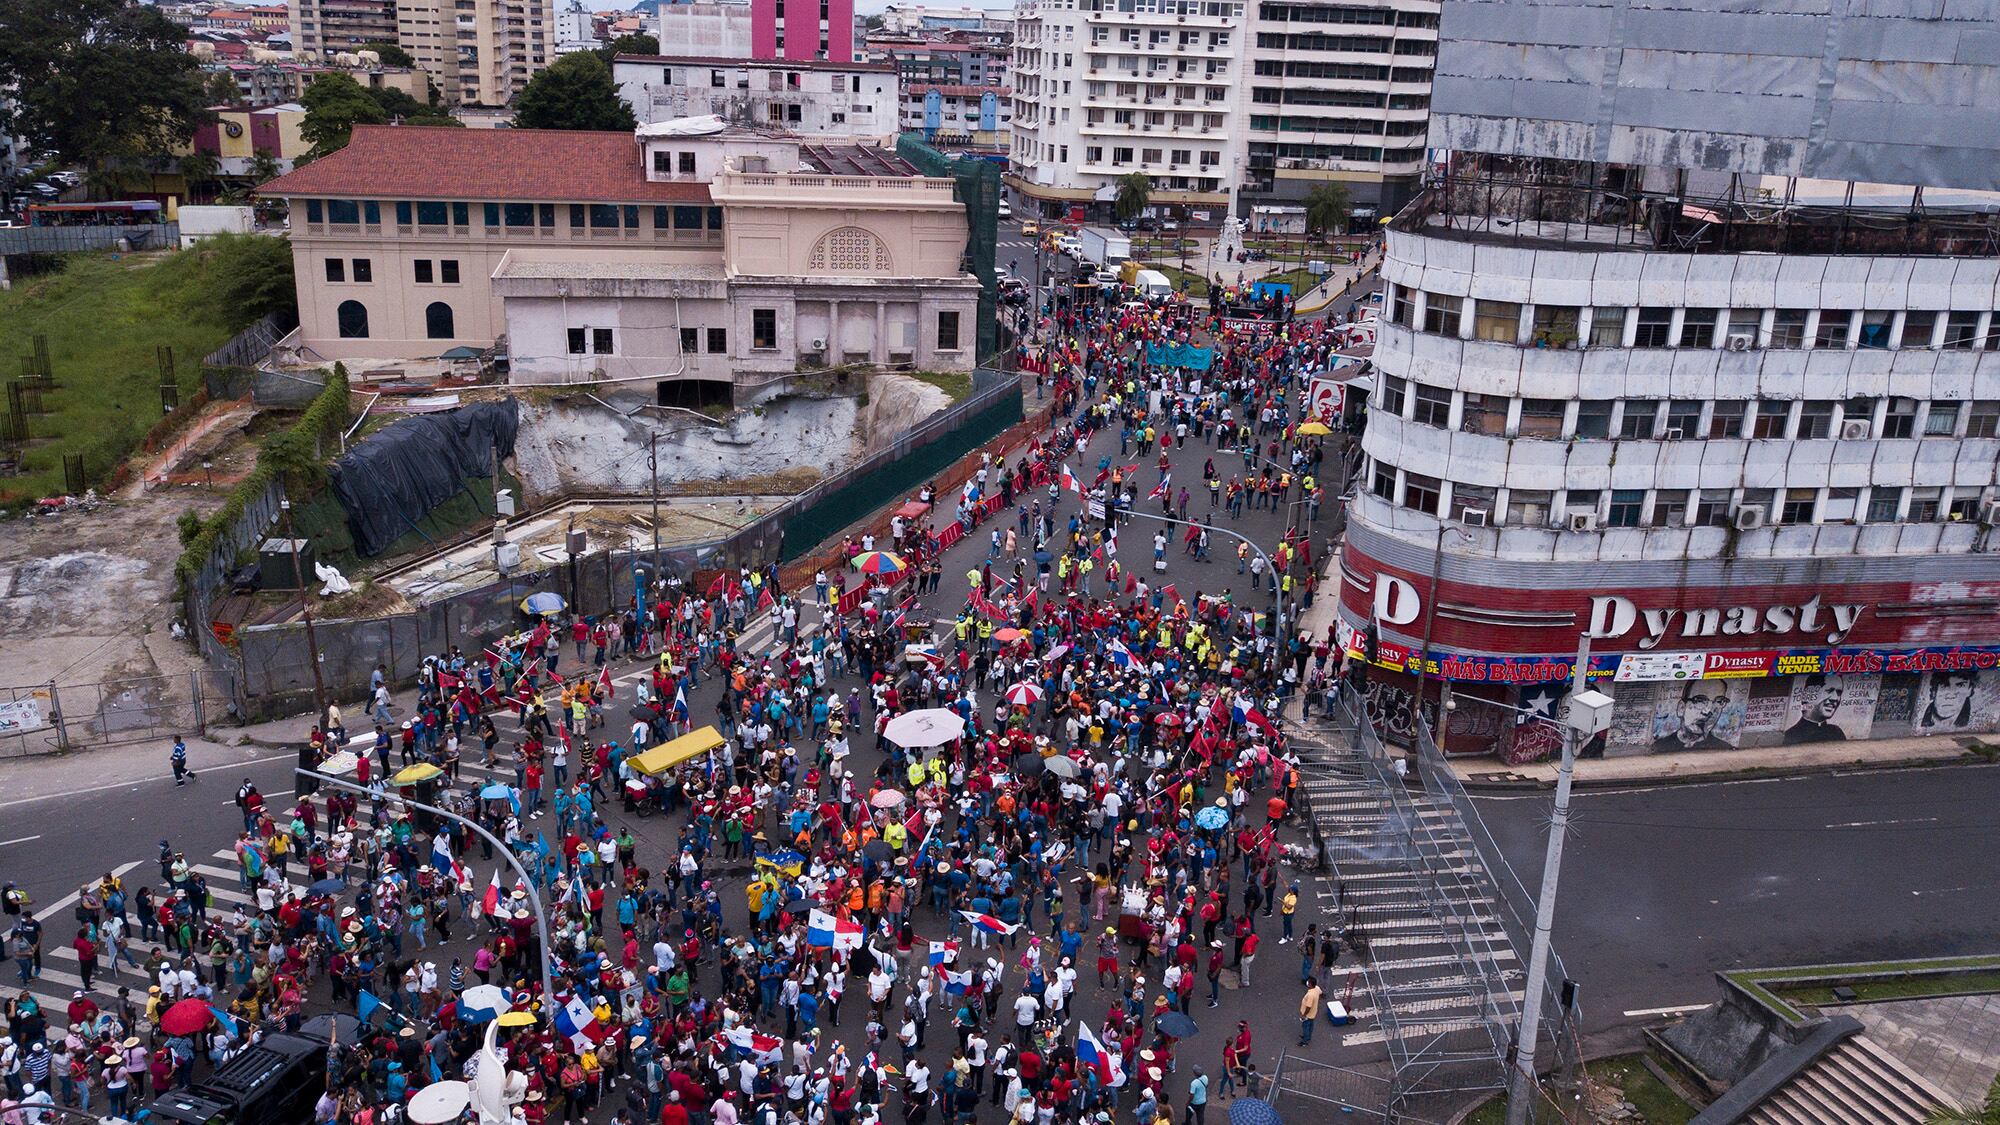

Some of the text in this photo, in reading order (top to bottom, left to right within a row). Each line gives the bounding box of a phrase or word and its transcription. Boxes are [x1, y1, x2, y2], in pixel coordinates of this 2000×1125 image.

[1373, 571, 1421, 625] D
[1588, 594, 1866, 650] Dynasty
[1709, 655, 1767, 668] Dynasty
[1778, 655, 1820, 664] NADIE
[1824, 650, 1883, 672] MÁS
[1887, 652, 1996, 671] BARATO
[1408, 663, 1439, 674] VEDE
[1441, 657, 1569, 682] MÁS BARATO
[1777, 664, 1821, 674] VENDE
[1745, 712, 1761, 720] QUE
